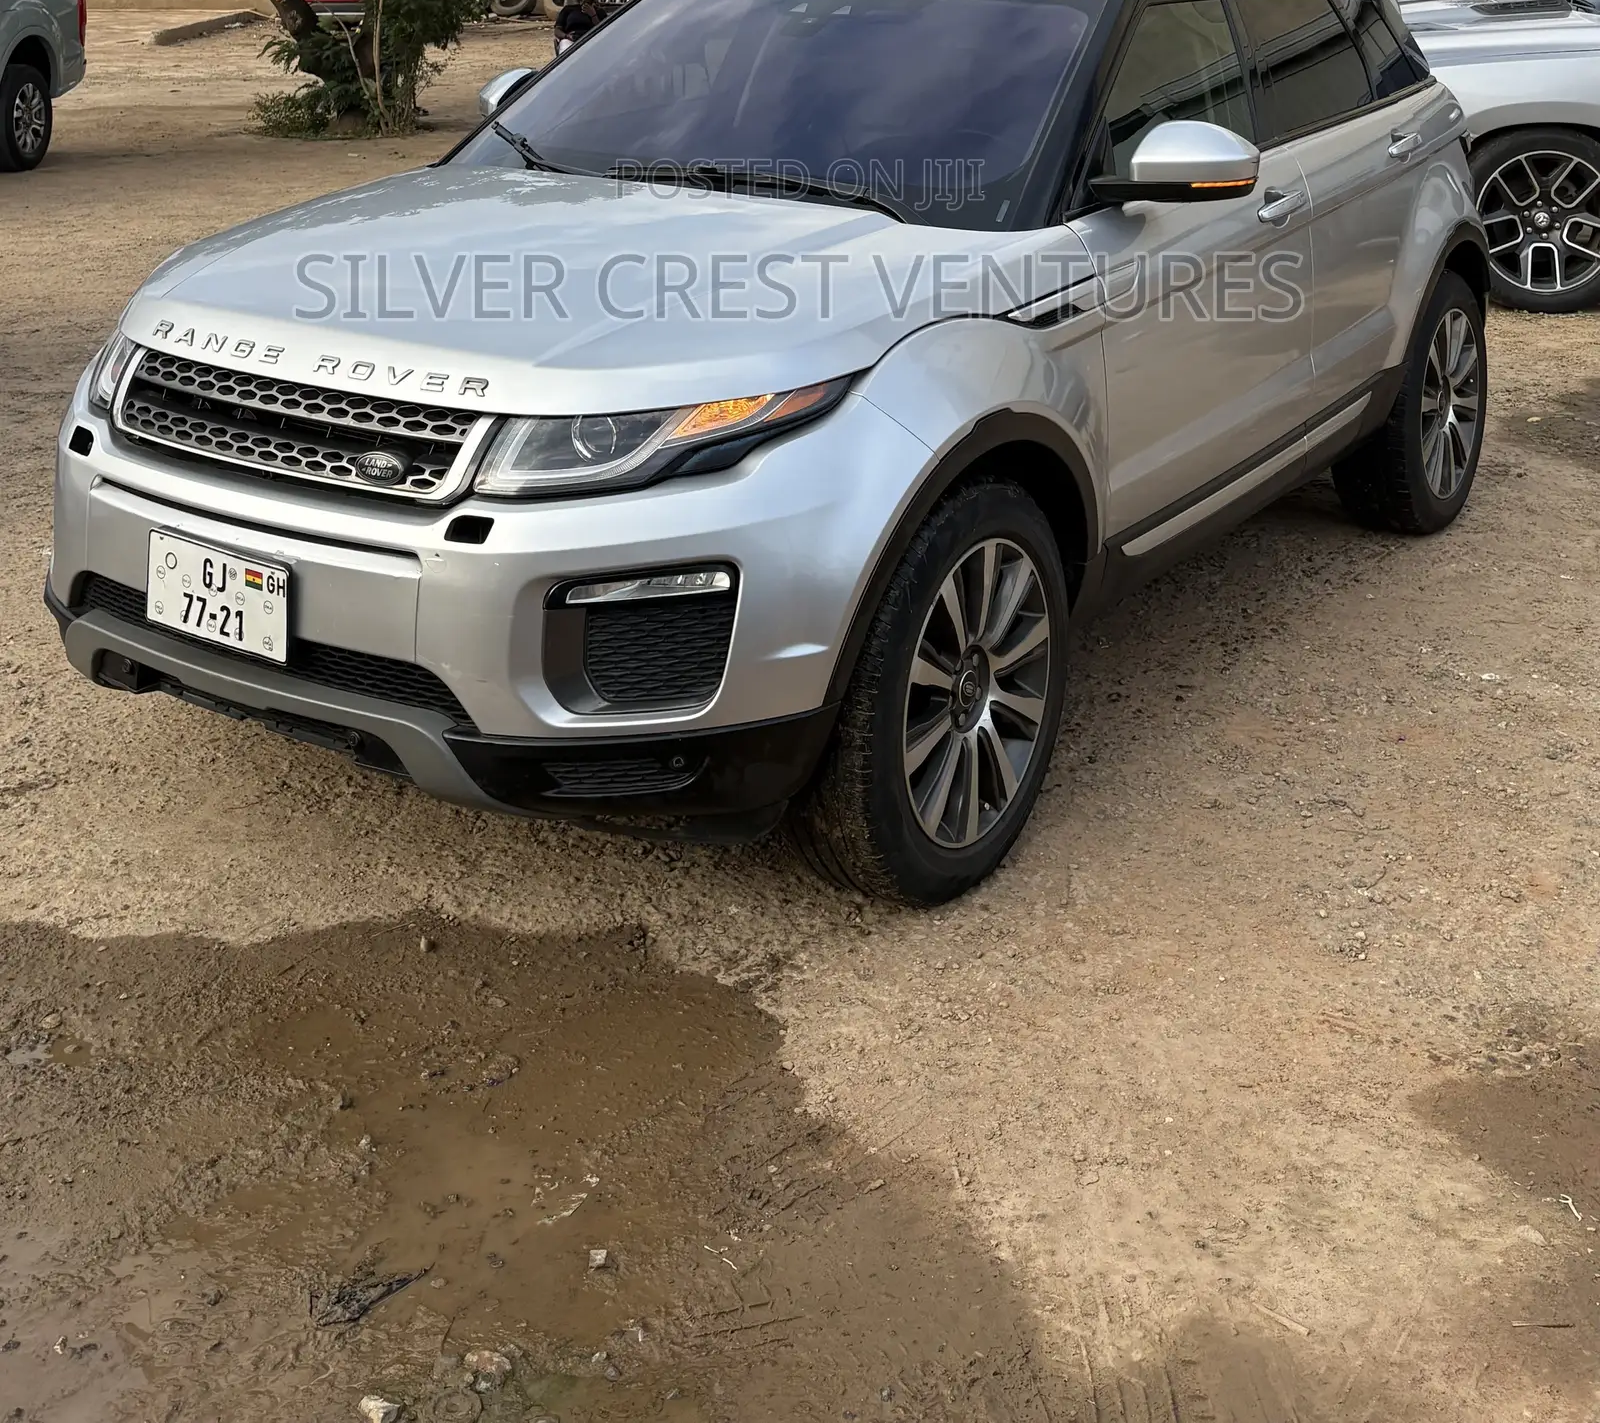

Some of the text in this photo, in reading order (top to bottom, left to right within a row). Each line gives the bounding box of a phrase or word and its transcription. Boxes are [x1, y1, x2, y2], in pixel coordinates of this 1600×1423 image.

[152, 319, 490, 398] RANGE ROVER
[365, 458, 388, 468] LAND
[365, 467, 393, 478] ROVER
[202, 558, 286, 598] GJ GH
[183, 592, 244, 642] 77-21
